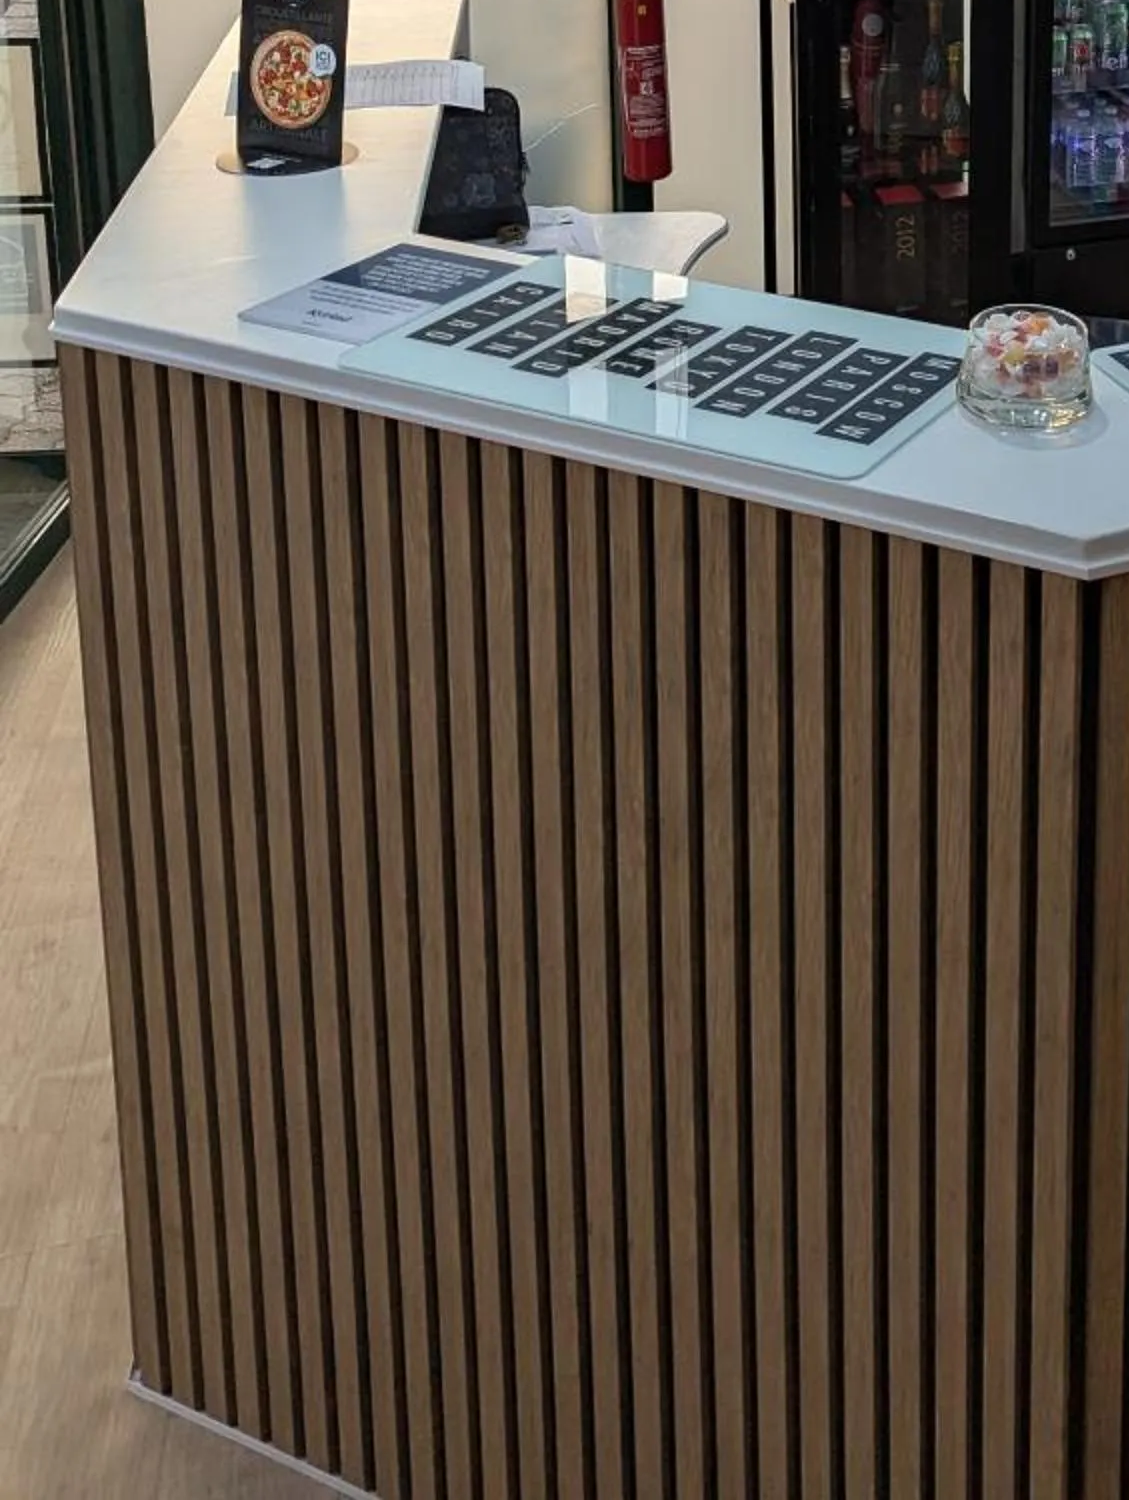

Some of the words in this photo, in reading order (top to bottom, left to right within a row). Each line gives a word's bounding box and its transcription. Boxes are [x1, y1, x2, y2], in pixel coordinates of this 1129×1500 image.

[896, 214, 915, 261] 2012
[425, 284, 545, 342] CAIRO
[531, 302, 672, 372] MADRID
[610, 323, 705, 373] ROME
[664, 332, 775, 392] TOKYO
[709, 336, 843, 413] LONDON
[785, 353, 892, 418] PARIS
[835, 356, 957, 439] MOSCOW
